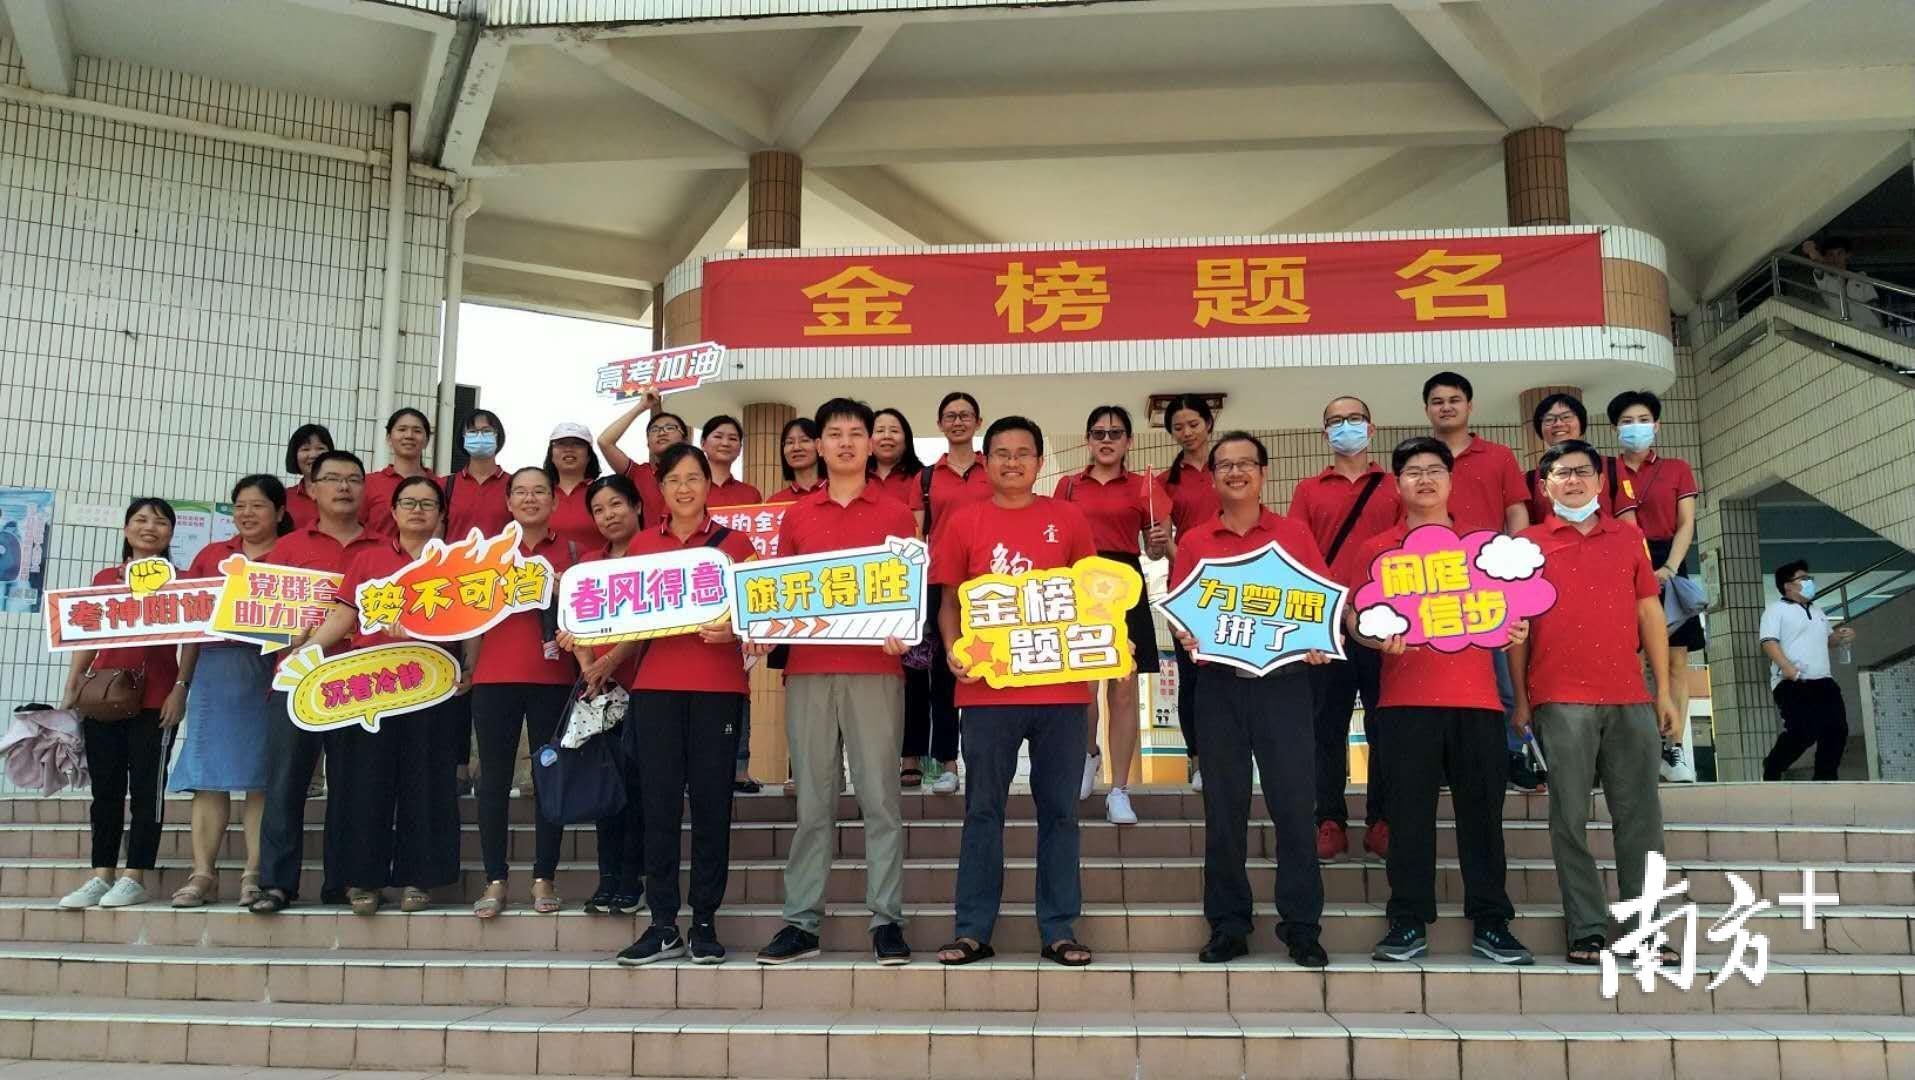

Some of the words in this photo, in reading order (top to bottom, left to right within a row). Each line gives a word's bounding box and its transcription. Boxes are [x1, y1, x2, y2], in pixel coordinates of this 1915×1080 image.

[801, 249, 1509, 336] 金榜题名
[596, 348, 720, 393] 高考加油
[361, 562, 548, 629] 势不可挡
[570, 560, 727, 622] 春风得意
[745, 558, 912, 614] 旗开得胜
[1381, 550, 1471, 599] 闲庭
[68, 591, 216, 632] 考神附体
[967, 576, 1077, 629] 金榜
[1197, 578, 1326, 623] 为梦想
[1418, 589, 1507, 639] 信步
[1009, 623, 1120, 676] 题名
[1215, 614, 1299, 651] 拼了
[321, 661, 424, 708] 沉着冷静
